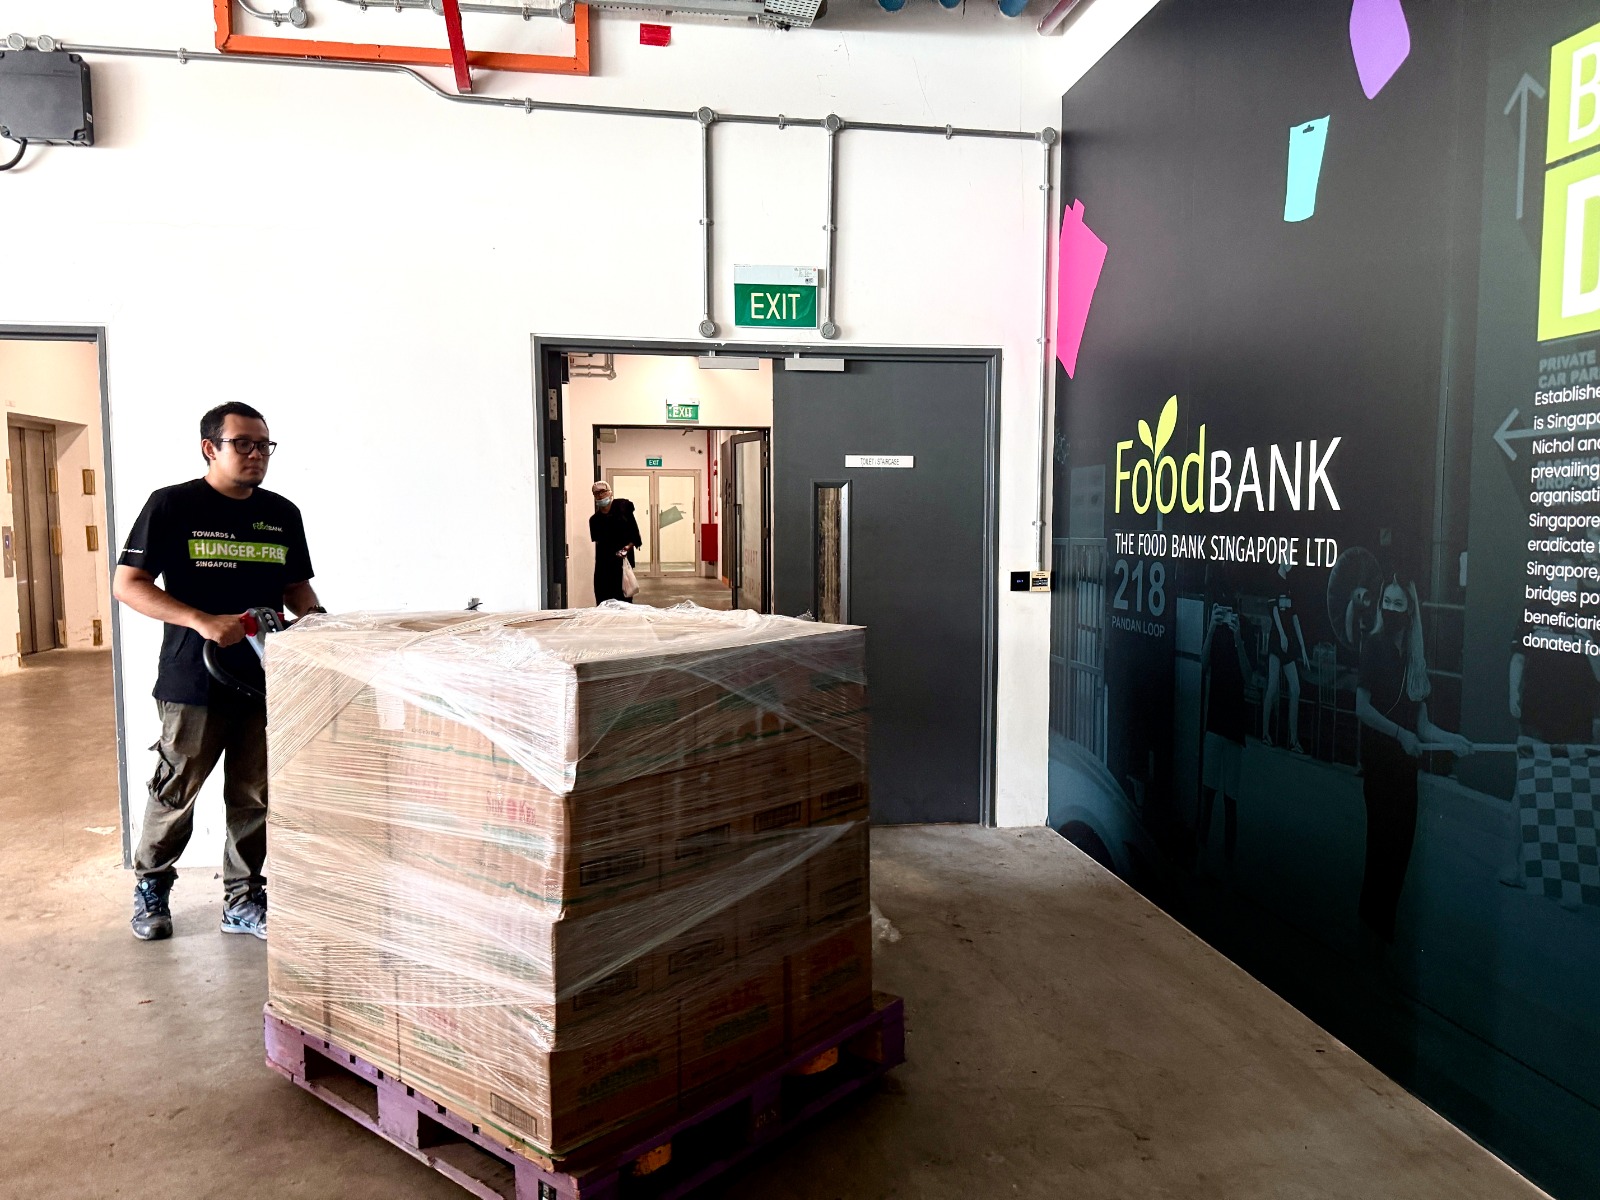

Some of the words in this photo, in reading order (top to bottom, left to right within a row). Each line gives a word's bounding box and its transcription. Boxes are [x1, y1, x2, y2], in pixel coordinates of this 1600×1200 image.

[750, 292, 801, 320] EXIT
[1539, 350, 1597, 373] PRIVATE
[1538, 371, 1567, 389] CAR
[1570, 366, 1600, 383] PAR
[672, 405, 693, 418] EXIT
[1533, 416, 1544, 430] is
[1532, 437, 1575, 455] Nichol
[1115, 423, 1342, 514] FoodBANK
[1531, 461, 1600, 483] prevailing
[1529, 512, 1600, 532] Singapore
[191, 530, 229, 539] TOWARDS
[1527, 537, 1595, 554] eradicate
[1115, 533, 1135, 555] THE
[1138, 532, 1167, 557] FOOD
[1171, 534, 1207, 560] BANK
[1210, 535, 1299, 566] SINGAPORE
[1306, 537, 1338, 569] LTD
[195, 560, 238, 569] SINGAPORE
[1526, 560, 1600, 582] Singapore,
[1113, 559, 1166, 617] 218
[1525, 585, 1577, 606] bridges
[1580, 591, 1600, 608] po
[1111, 616, 1142, 633] PANDAN
[1142, 621, 1166, 638] LOOP
[1522, 633, 1582, 654] donated
[1584, 639, 1600, 657] fo
